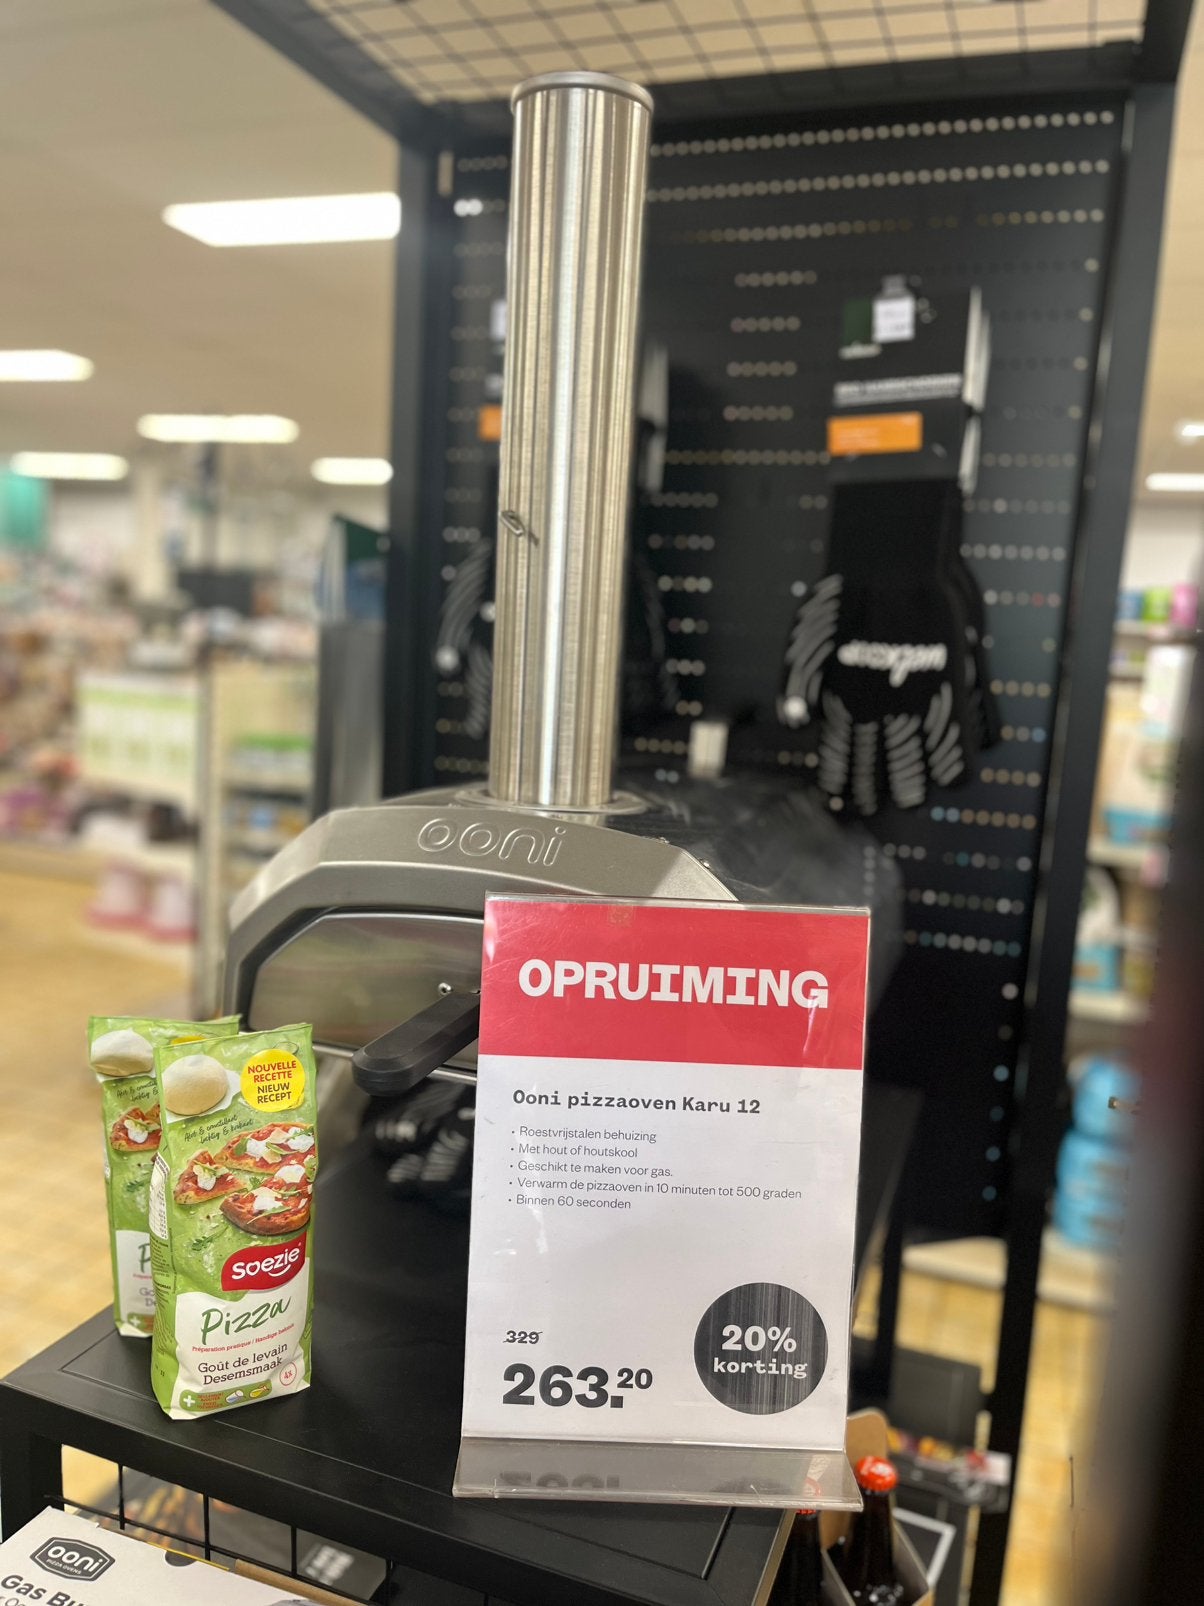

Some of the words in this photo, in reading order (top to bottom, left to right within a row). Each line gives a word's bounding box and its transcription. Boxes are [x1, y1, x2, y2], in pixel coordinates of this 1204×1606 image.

[417, 818, 567, 867] ooni
[518, 958, 830, 1009] OPRUIMING
[247, 1060, 297, 1075] NOUVELLE
[253, 1070, 293, 1083] RECETTE
[257, 1082, 291, 1094] NIEUW
[257, 1091, 292, 1104] RECEPT
[512, 1089, 562, 1106] Ooni
[567, 1091, 676, 1111] pizzaoven
[682, 1096, 731, 1113] Karu
[737, 1098, 761, 1114] 12
[519, 1125, 602, 1141] Roestvrijstalen
[603, 1128, 657, 1145] behuizing
[518, 1143, 541, 1155] Met
[542, 1143, 568, 1156] hout
[569, 1144, 583, 1156] of
[583, 1145, 638, 1158] houtskool
[517, 1159, 568, 1173] Geschikt
[570, 1163, 582, 1173] te
[583, 1163, 622, 1175] maken
[623, 1167, 649, 1176] voor
[650, 1168, 673, 1179] gas.
[517, 1176, 568, 1189] Verwarm
[569, 1179, 585, 1190] de
[586, 1179, 642, 1193] pizzaoven
[644, 1182, 654, 1193] in
[656, 1182, 669, 1194] 10
[671, 1183, 716, 1196] minuten
[718, 1187, 734, 1197] tot
[736, 1186, 761, 1198] 500
[762, 1188, 802, 1201] graden
[516, 1193, 555, 1206] Binnen
[557, 1195, 575, 1207] 60
[576, 1198, 632, 1209] seconden
[231, 1247, 300, 1280] soezie
[200, 1296, 292, 1345] Pizza
[255, 1332, 278, 1343] Handige
[503, 1329, 544, 1345] 329
[721, 1324, 797, 1353] 20%
[198, 1360, 230, 1373] Goût
[232, 1357, 249, 1367] de
[253, 1343, 288, 1362] levain
[713, 1357, 808, 1379] korting
[203, 1356, 284, 1385] Desemsmaak
[47, 1545, 103, 1572] ooni
[62, 1564, 82, 1575] OVENS
[0, 1574, 47, 1600] Gas
